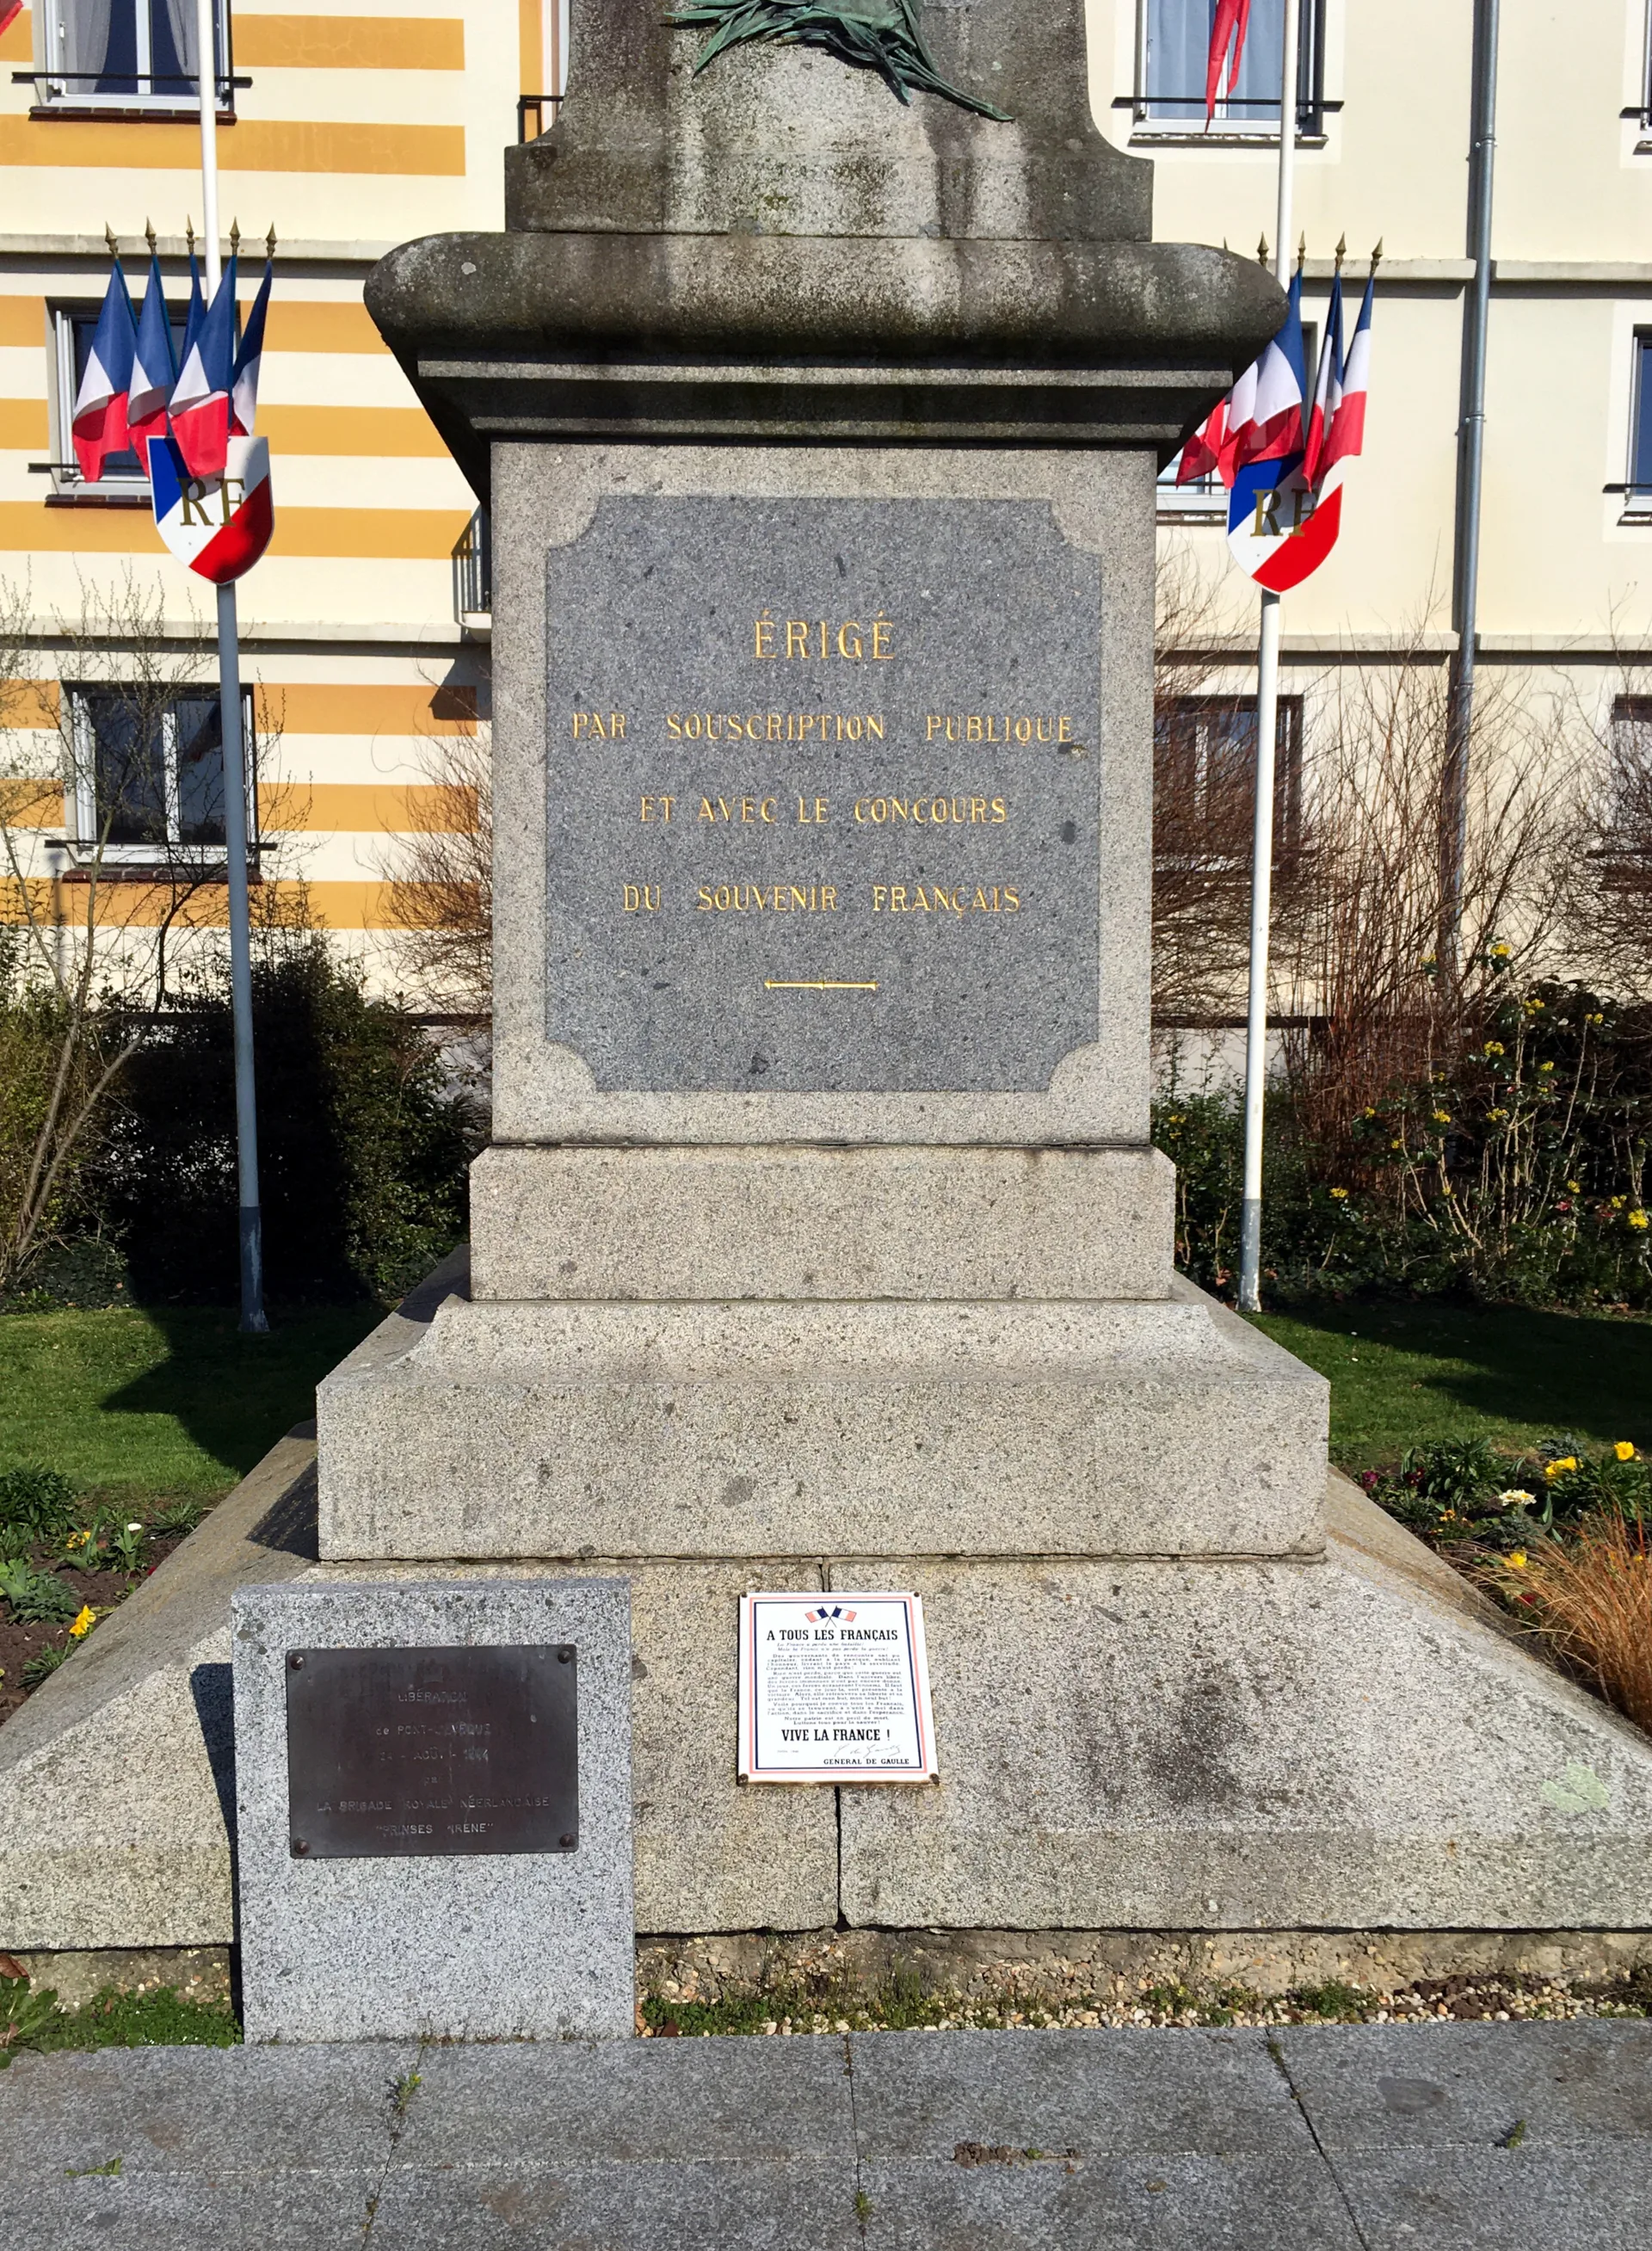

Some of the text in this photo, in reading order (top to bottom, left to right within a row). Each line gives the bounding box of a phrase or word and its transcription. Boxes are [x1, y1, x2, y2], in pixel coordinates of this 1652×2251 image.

[176, 477, 245, 527] RF
[1250, 488, 1320, 538] RF
[754, 609, 896, 660] ÉRIGÉ
[571, 712, 1074, 746] PAR SOUSCRIPTION PUBLIQUE
[639, 797, 1008, 823] ET AVEC LE CONCOURS
[623, 885, 1021, 919] DU SOUVENIR FRANÇAIS
[767, 1629, 898, 1641] A TOUS LES FRANÇAIS
[781, 1729, 809, 1741] VIVE
[814, 1729, 829, 1740] LA
[833, 1729, 880, 1740] FRANCE
[317, 1801, 332, 1812] LA
[339, 1801, 392, 1811] BRIGADE
